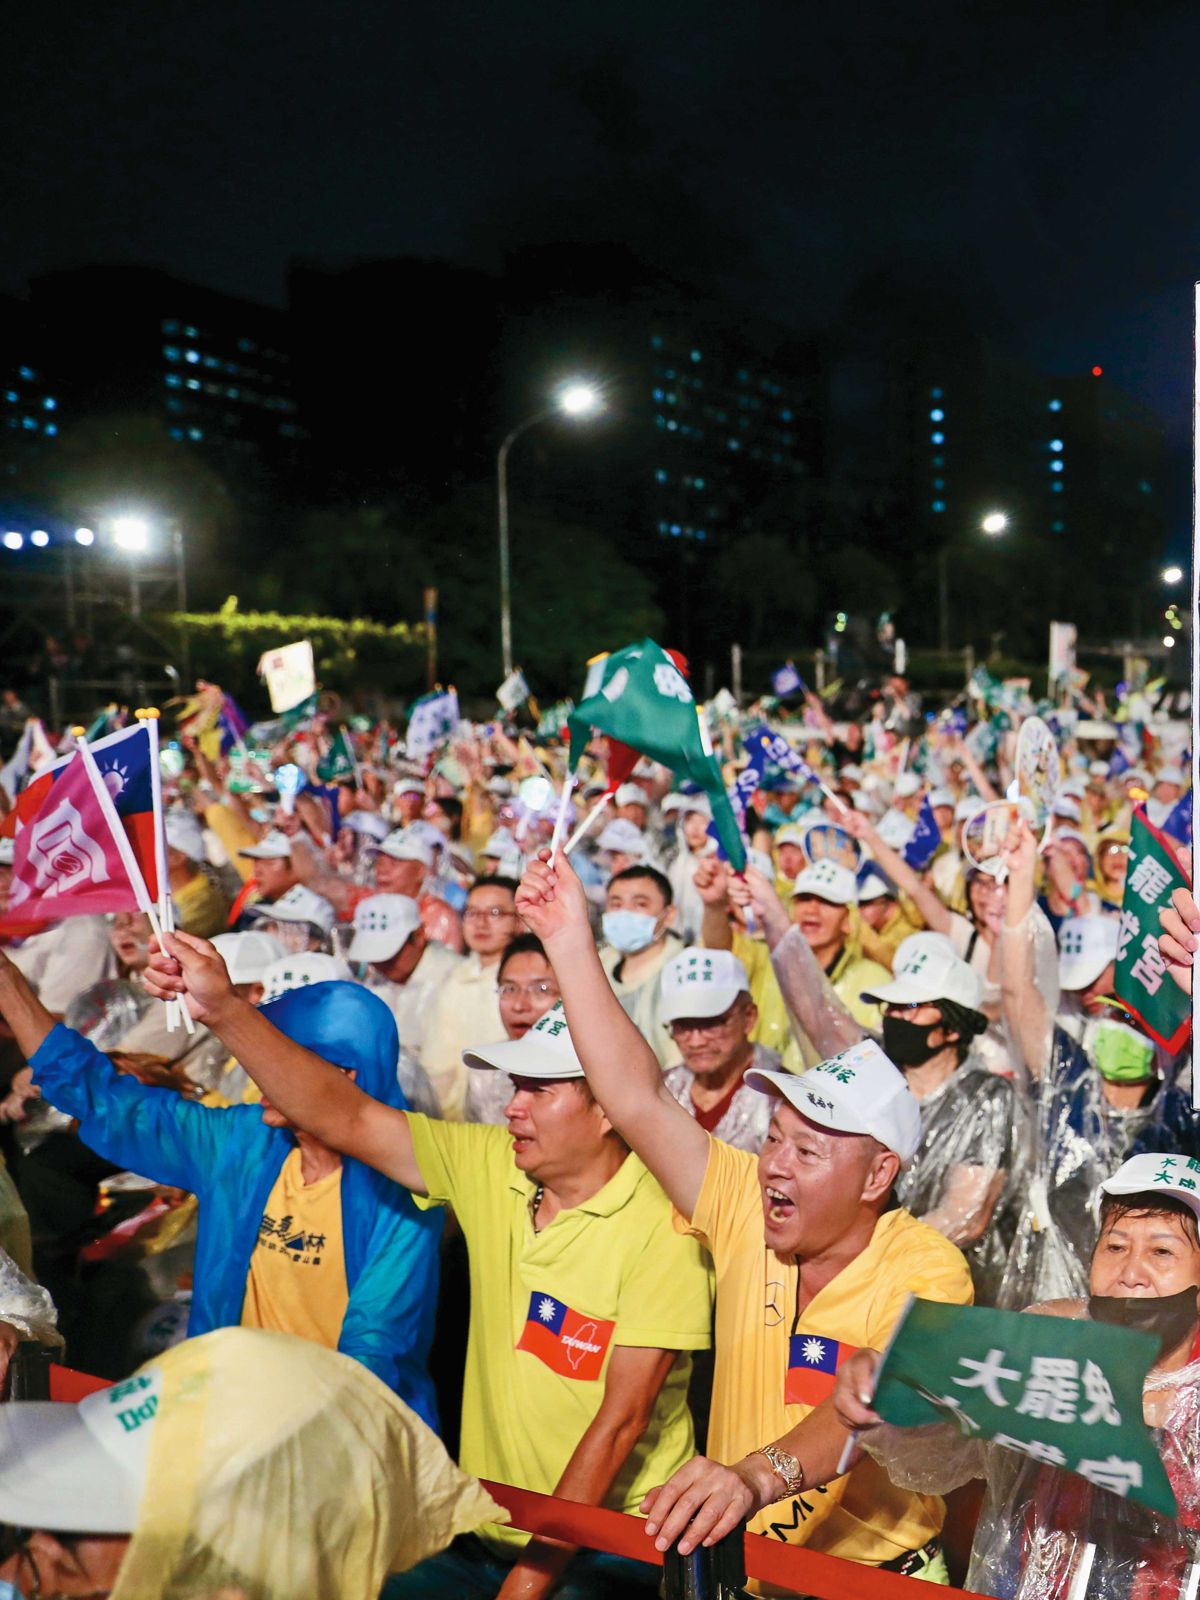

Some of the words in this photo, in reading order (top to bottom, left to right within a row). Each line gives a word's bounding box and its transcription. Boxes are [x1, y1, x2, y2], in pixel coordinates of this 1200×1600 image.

[561, 1335, 602, 1354] TAIWAN
[951, 1348, 1122, 1427] 大罷免
